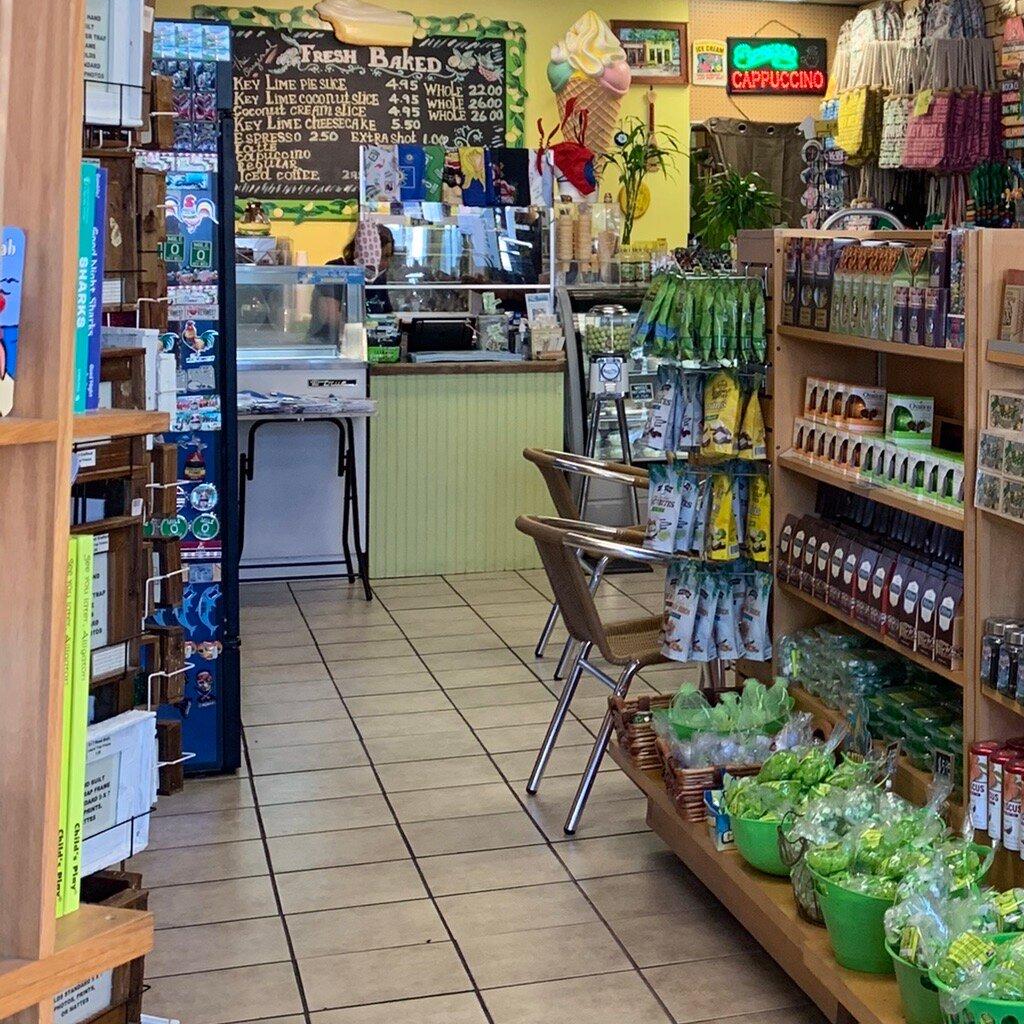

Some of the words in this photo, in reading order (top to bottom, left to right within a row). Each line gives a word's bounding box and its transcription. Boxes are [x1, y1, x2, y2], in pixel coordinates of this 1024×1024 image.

[299, 44, 357, 64] FRESH
[695, 45, 705, 53] ICE
[706, 44, 725, 53] CREAM
[233, 77, 260, 91] KEY
[265, 74, 297, 91] LIME
[300, 79, 318, 91] PIE
[319, 78, 347, 91] SLICE
[385, 78, 419, 91] 4.95
[423, 81, 463, 97] WHOLE
[731, 70, 824, 89] CAPPUCCINO
[233, 91, 259, 105] KEY
[265, 91, 297, 105] LIME
[388, 93, 420, 105] 4.95
[426, 97, 465, 110] WHOLE
[233, 116, 263, 132] KEY
[266, 115, 303, 130] LIME
[390, 119, 421, 131] 5.50
[388, 106, 421, 118] 4.95
[427, 110, 467, 122] WHOLE
[234, 131, 302, 145] ESPRESSO
[170, 243, 180, 256] 0
[196, 249, 206, 261] 0
[77, 256, 89, 329] SHARKS
[80, 630, 88, 682] Alligator
[72, 822, 80, 861] Child's
[70, 865, 79, 891] Play
